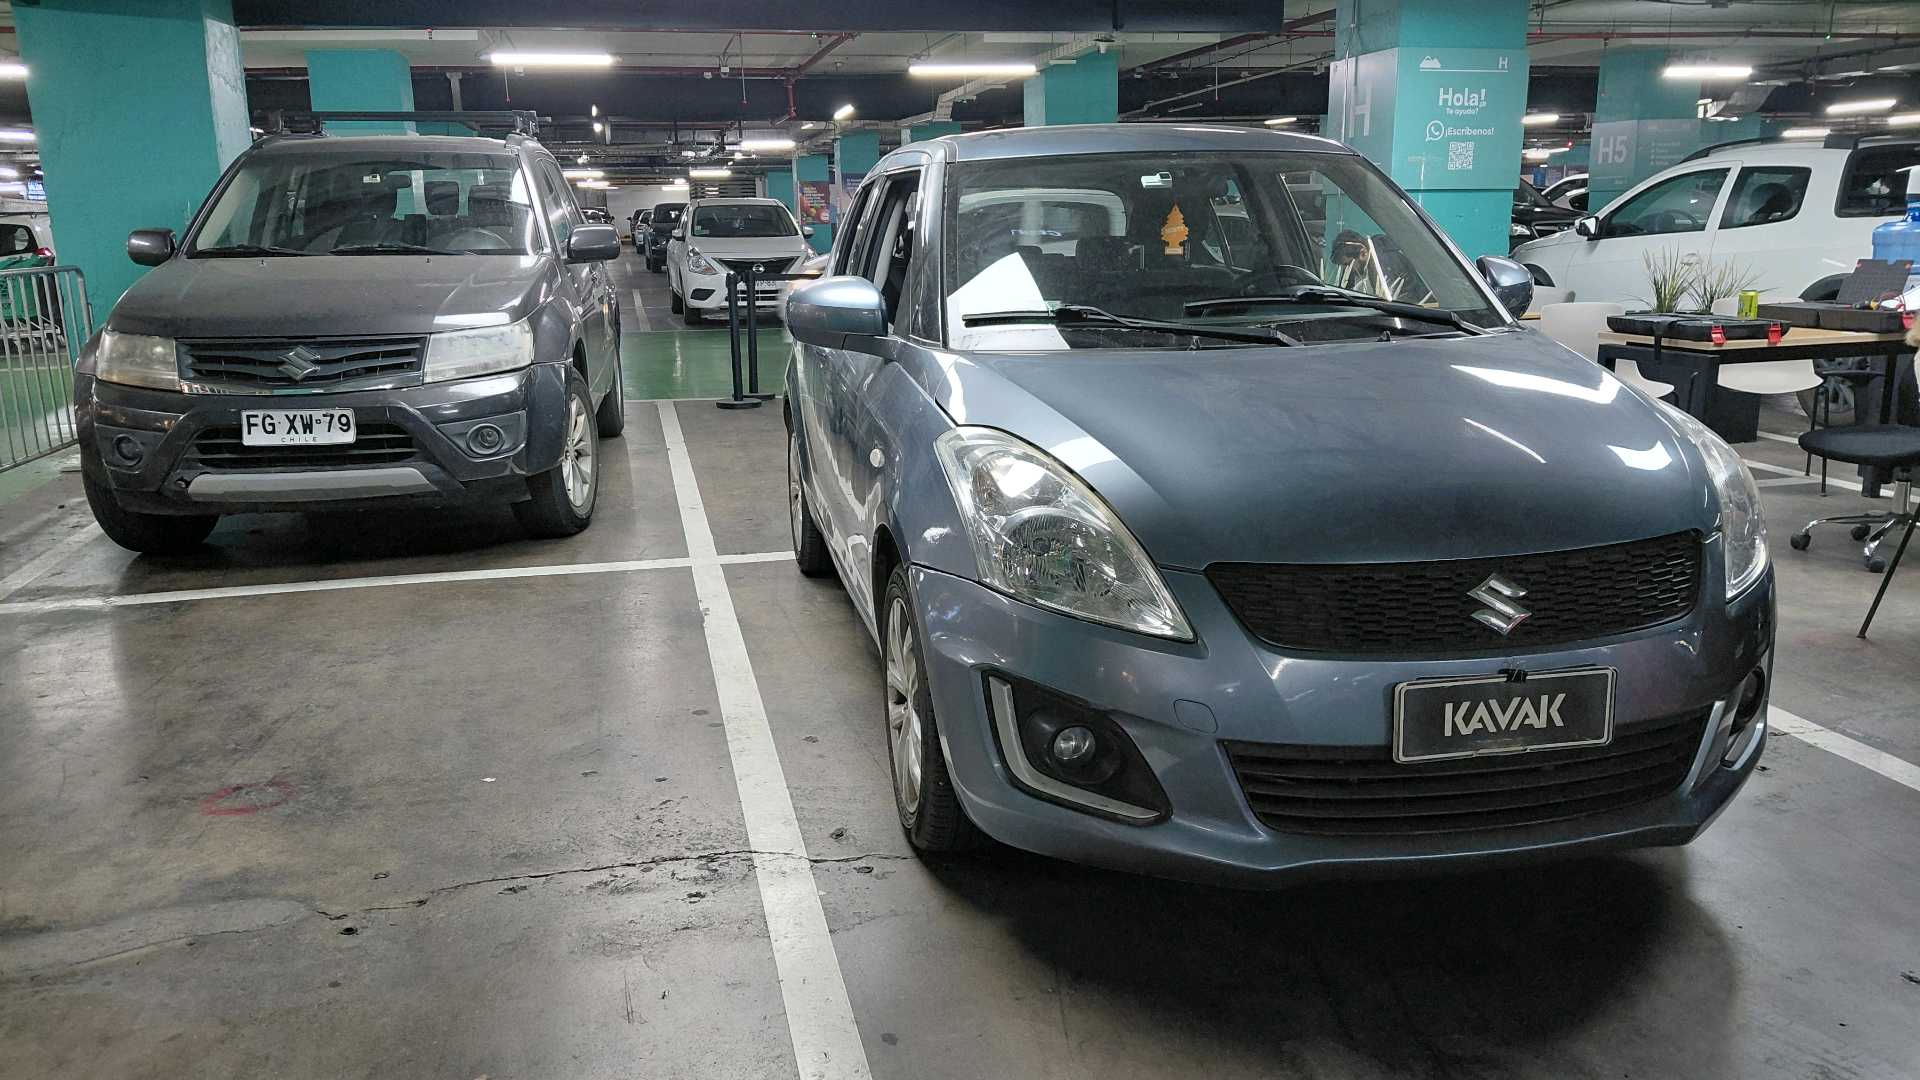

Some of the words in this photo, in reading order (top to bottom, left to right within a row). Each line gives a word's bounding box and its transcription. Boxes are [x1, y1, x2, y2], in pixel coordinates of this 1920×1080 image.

[1499, 56, 1509, 69] H
[1349, 82, 1373, 138] H
[1439, 87, 1487, 107] Hola!
[1597, 135, 1629, 165] H5
[1444, 693, 1567, 737] KAVAK
